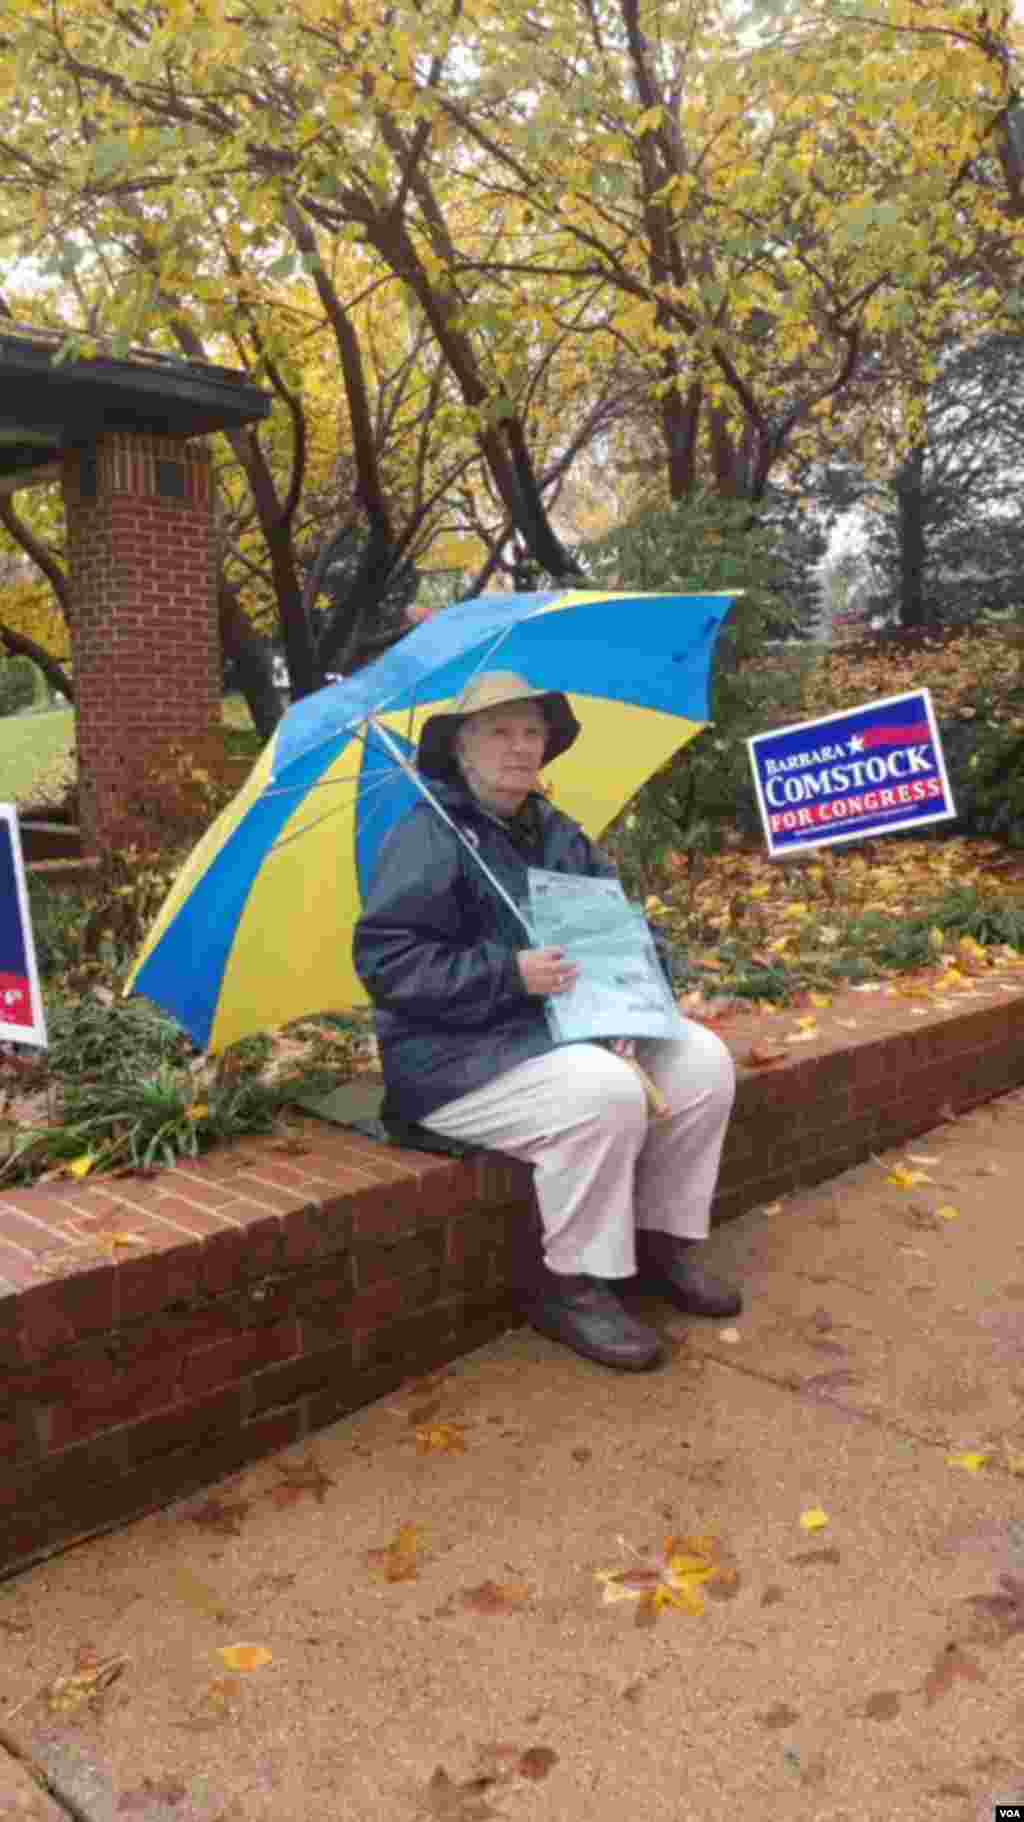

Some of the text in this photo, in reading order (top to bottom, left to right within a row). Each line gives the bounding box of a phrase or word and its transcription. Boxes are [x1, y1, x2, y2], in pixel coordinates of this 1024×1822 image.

[766, 745, 846, 774] BARBARA
[766, 745, 934, 806] COMSTOCK
[771, 809, 814, 832] FOR
[818, 779, 942, 821] CONGRESS
